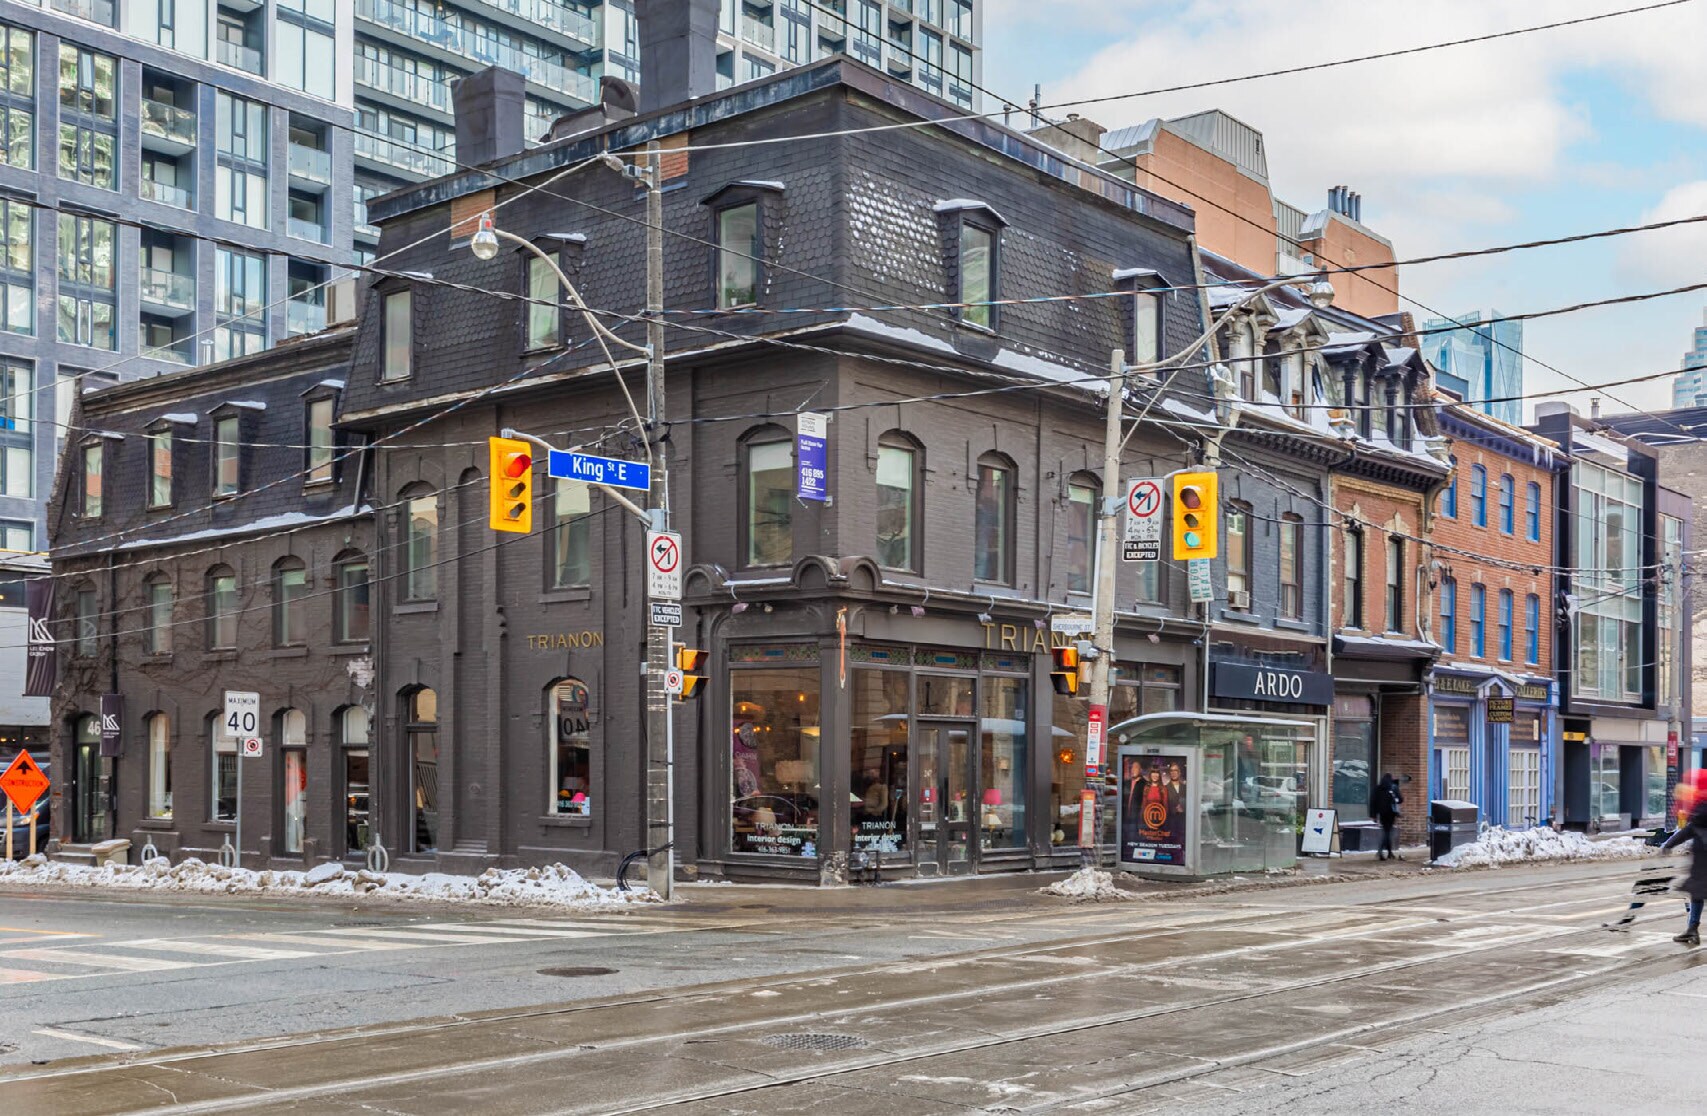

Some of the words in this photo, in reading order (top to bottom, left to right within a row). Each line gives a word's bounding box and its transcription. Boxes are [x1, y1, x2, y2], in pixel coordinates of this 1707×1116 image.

[573, 457, 603, 481] King
[607, 462, 615, 472] St
[618, 467, 626, 480] E
[801, 468, 812, 477] 416
[654, 615, 679, 623] EXCEPTED
[527, 631, 604, 650] TRIANON
[981, 622, 1096, 654] TRIAN
[1254, 671, 1302, 698] ARDO
[1453, 679, 1472, 692] LAKE
[87, 721, 101, 735] 46
[228, 712, 255, 732] 40
[4, 779, 45, 787] CONSTRUCTION
[755, 822, 794, 830] TRIANON
[747, 834, 776, 843] Interior
[777, 836, 801, 846] design
[855, 834, 880, 842] Interior
[882, 832, 902, 842] design
